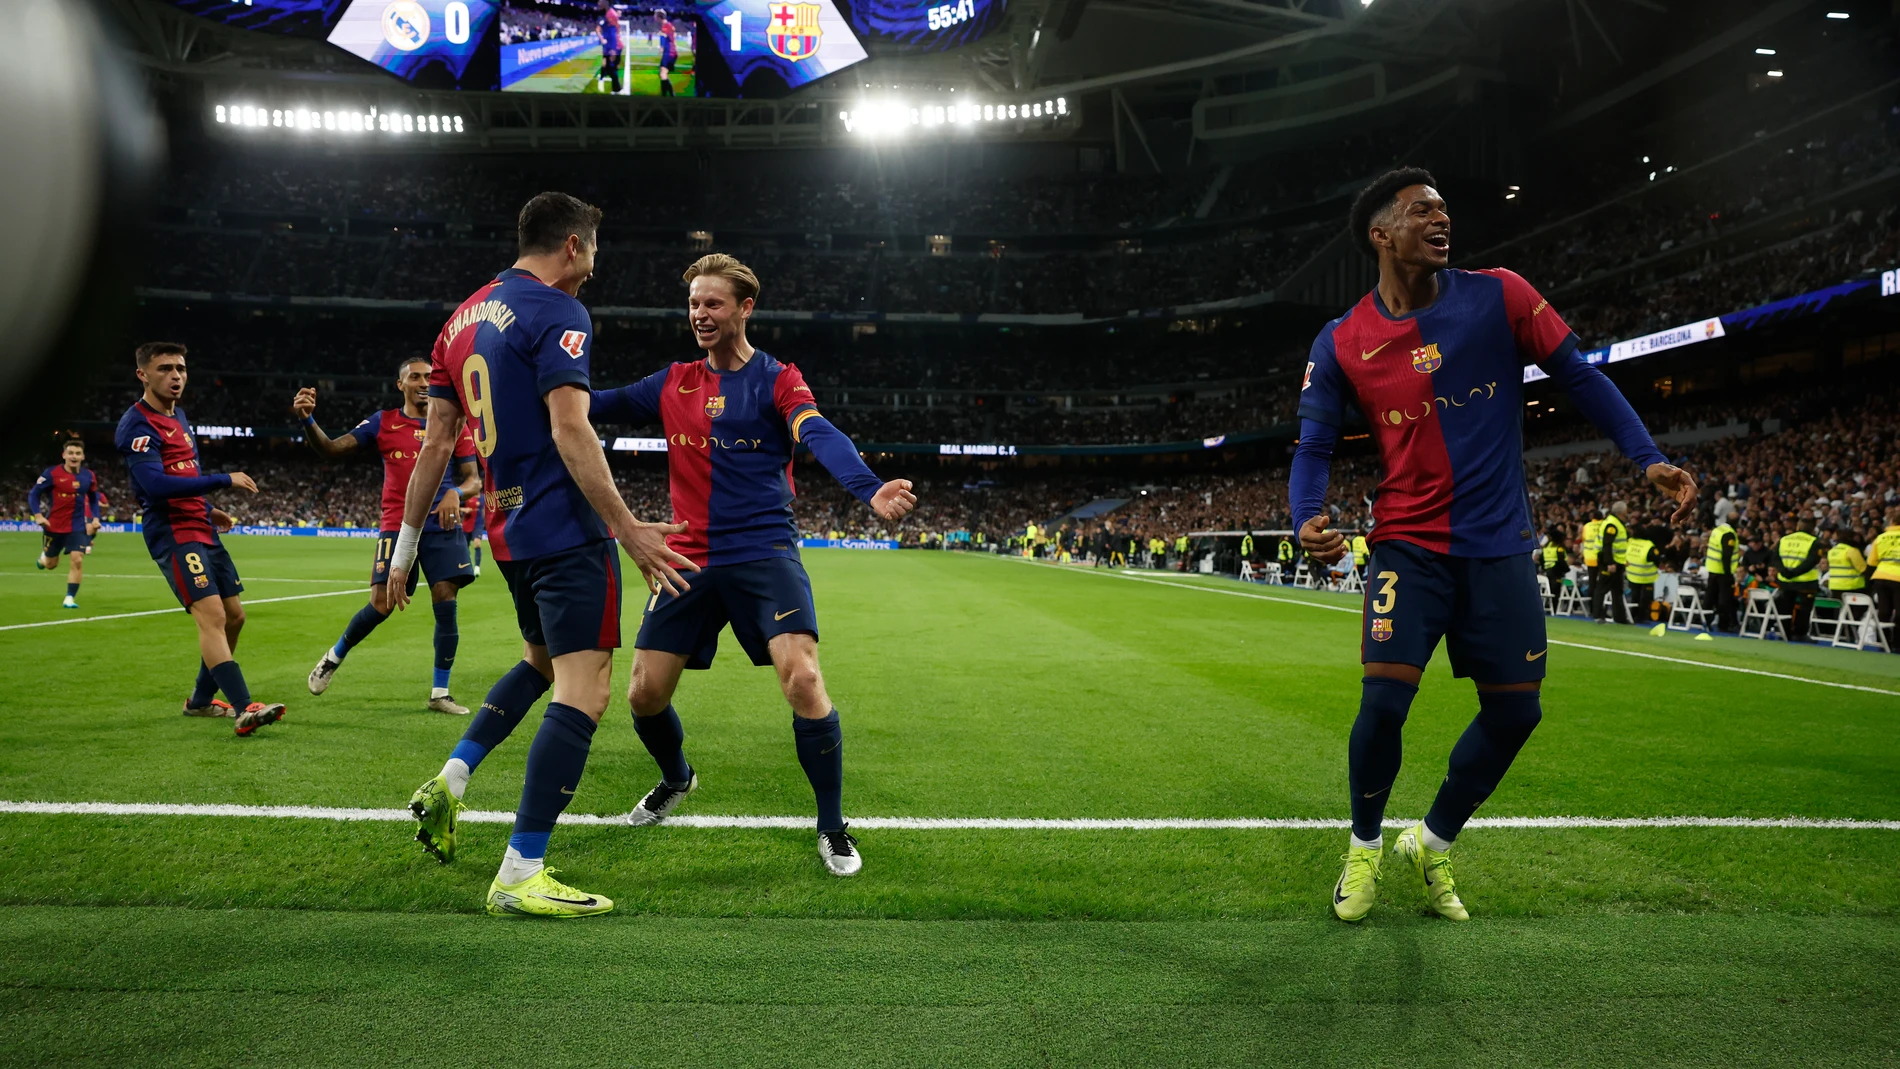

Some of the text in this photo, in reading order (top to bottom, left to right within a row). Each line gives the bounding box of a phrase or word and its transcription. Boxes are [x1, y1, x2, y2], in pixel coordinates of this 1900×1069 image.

[445, 1, 470, 45] 0
[928, 3, 975, 31] 55:41
[723, 10, 742, 52] 1
[443, 300, 516, 349] LEWANDOWSKI
[1650, 329, 1692, 349] BARCELONA
[462, 353, 497, 458] 9
[196, 425, 233, 437] MADRID
[939, 444, 962, 455] REAL
[963, 444, 997, 456] MADRID
[494, 485, 523, 500] UNHCR
[497, 494, 524, 508] ACNUR
[242, 525, 292, 536] Sanitas
[316, 529, 349, 537] Nuevo
[377, 537, 392, 560] 11
[841, 539, 891, 550] Sanitas
[185, 552, 205, 575] 8
[1372, 570, 1399, 614] 3
